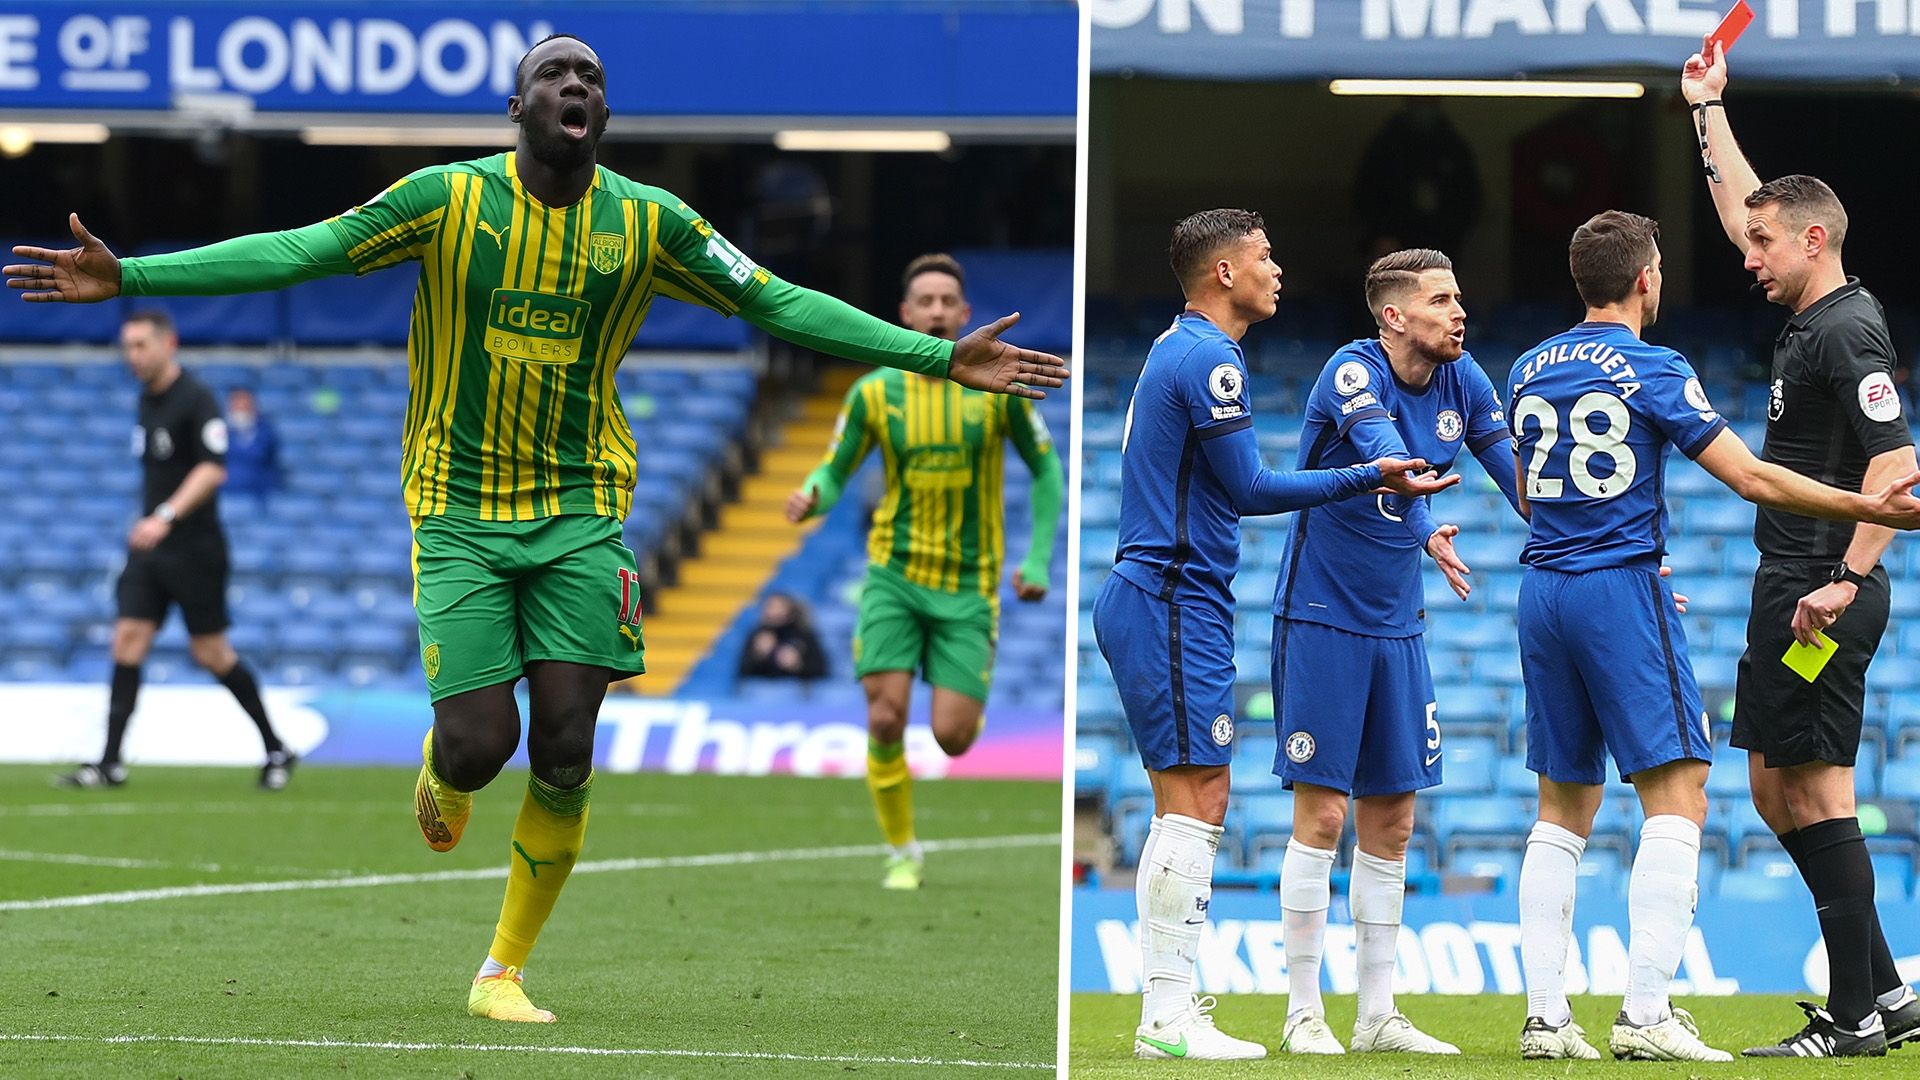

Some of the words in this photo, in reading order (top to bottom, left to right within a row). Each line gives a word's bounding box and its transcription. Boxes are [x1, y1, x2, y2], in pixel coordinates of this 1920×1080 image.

[58, 14, 150, 70] OF
[498, 295, 582, 334] ideal
[493, 336, 572, 357] BOILERS
[1867, 383, 1892, 403] EA
[1514, 392, 1637, 499] 28
[1425, 701, 1442, 751] 5
[1094, 918, 1286, 995] NKE
